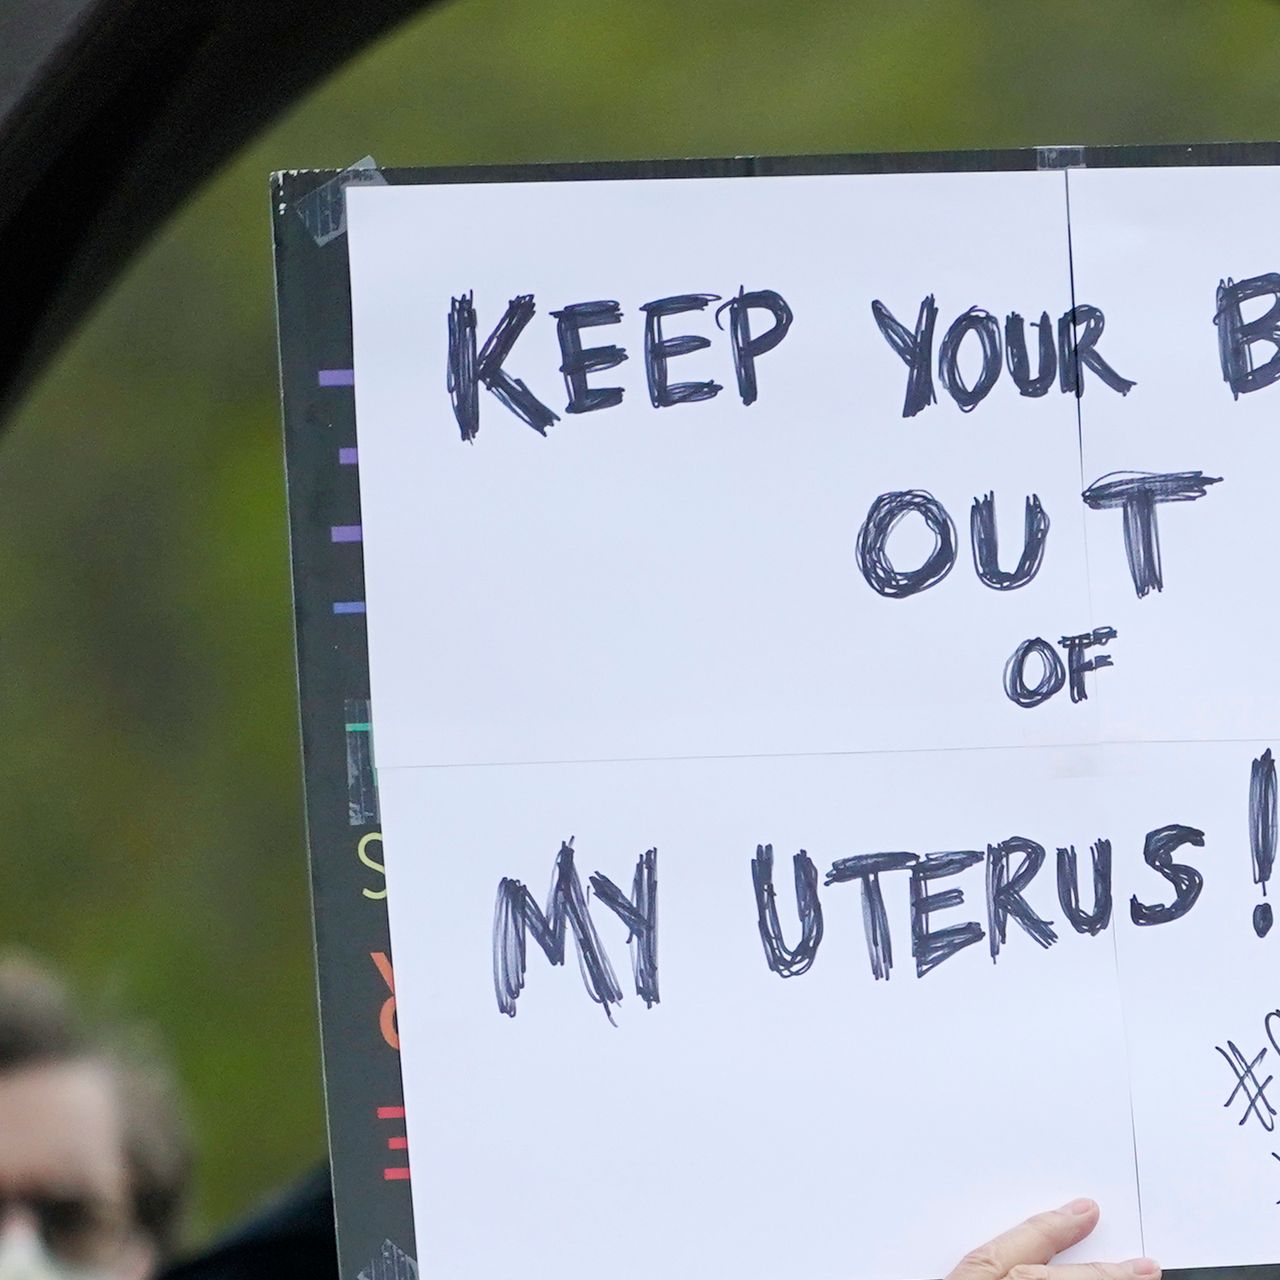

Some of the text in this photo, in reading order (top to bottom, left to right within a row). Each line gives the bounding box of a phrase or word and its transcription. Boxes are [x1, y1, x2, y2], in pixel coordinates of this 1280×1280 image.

[447, 284, 793, 445] KEEP
[872, 291, 1137, 417] YOUR
[856, 471, 1224, 600] OUT
[1003, 626, 1118, 709] OF
[492, 836, 664, 1028] MY
[750, 747, 1279, 982] UTERUS!
